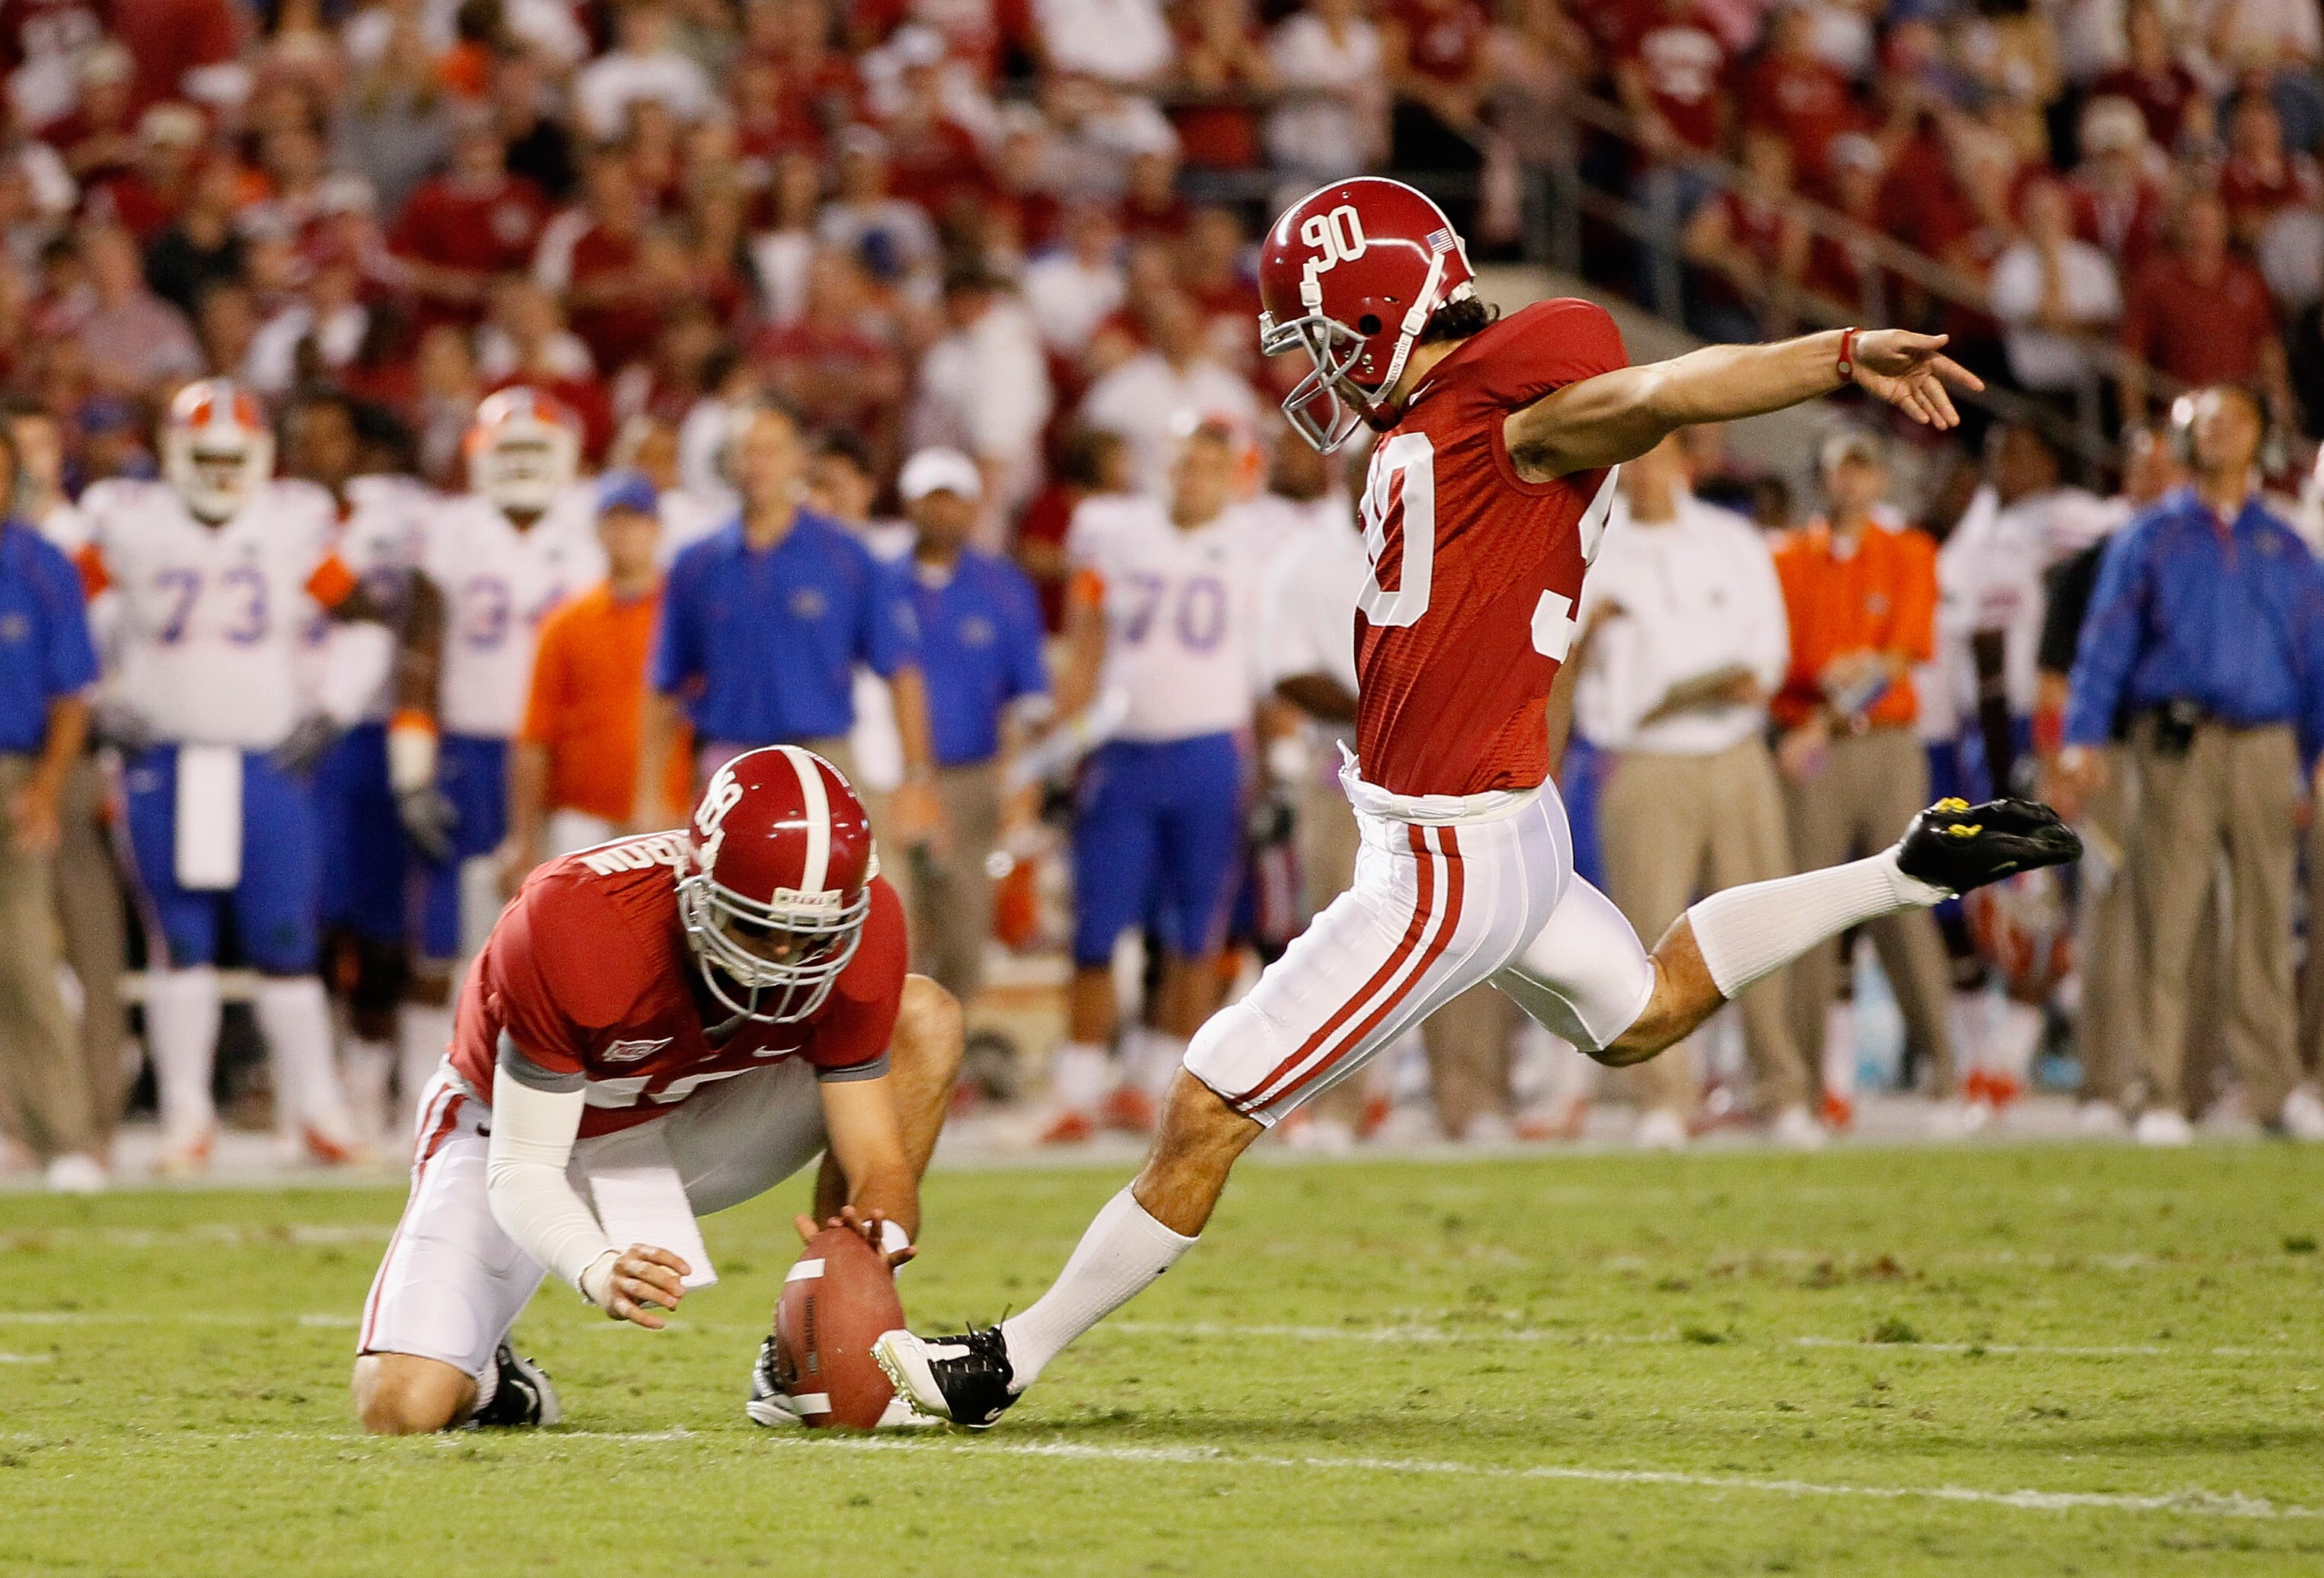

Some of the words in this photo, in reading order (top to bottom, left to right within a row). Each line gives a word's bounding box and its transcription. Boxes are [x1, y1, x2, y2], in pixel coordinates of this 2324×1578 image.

[1300, 204, 1367, 273] 90
[1396, 339, 1410, 360] TIDE
[152, 566, 271, 647] 73
[1115, 572, 1228, 653] 70
